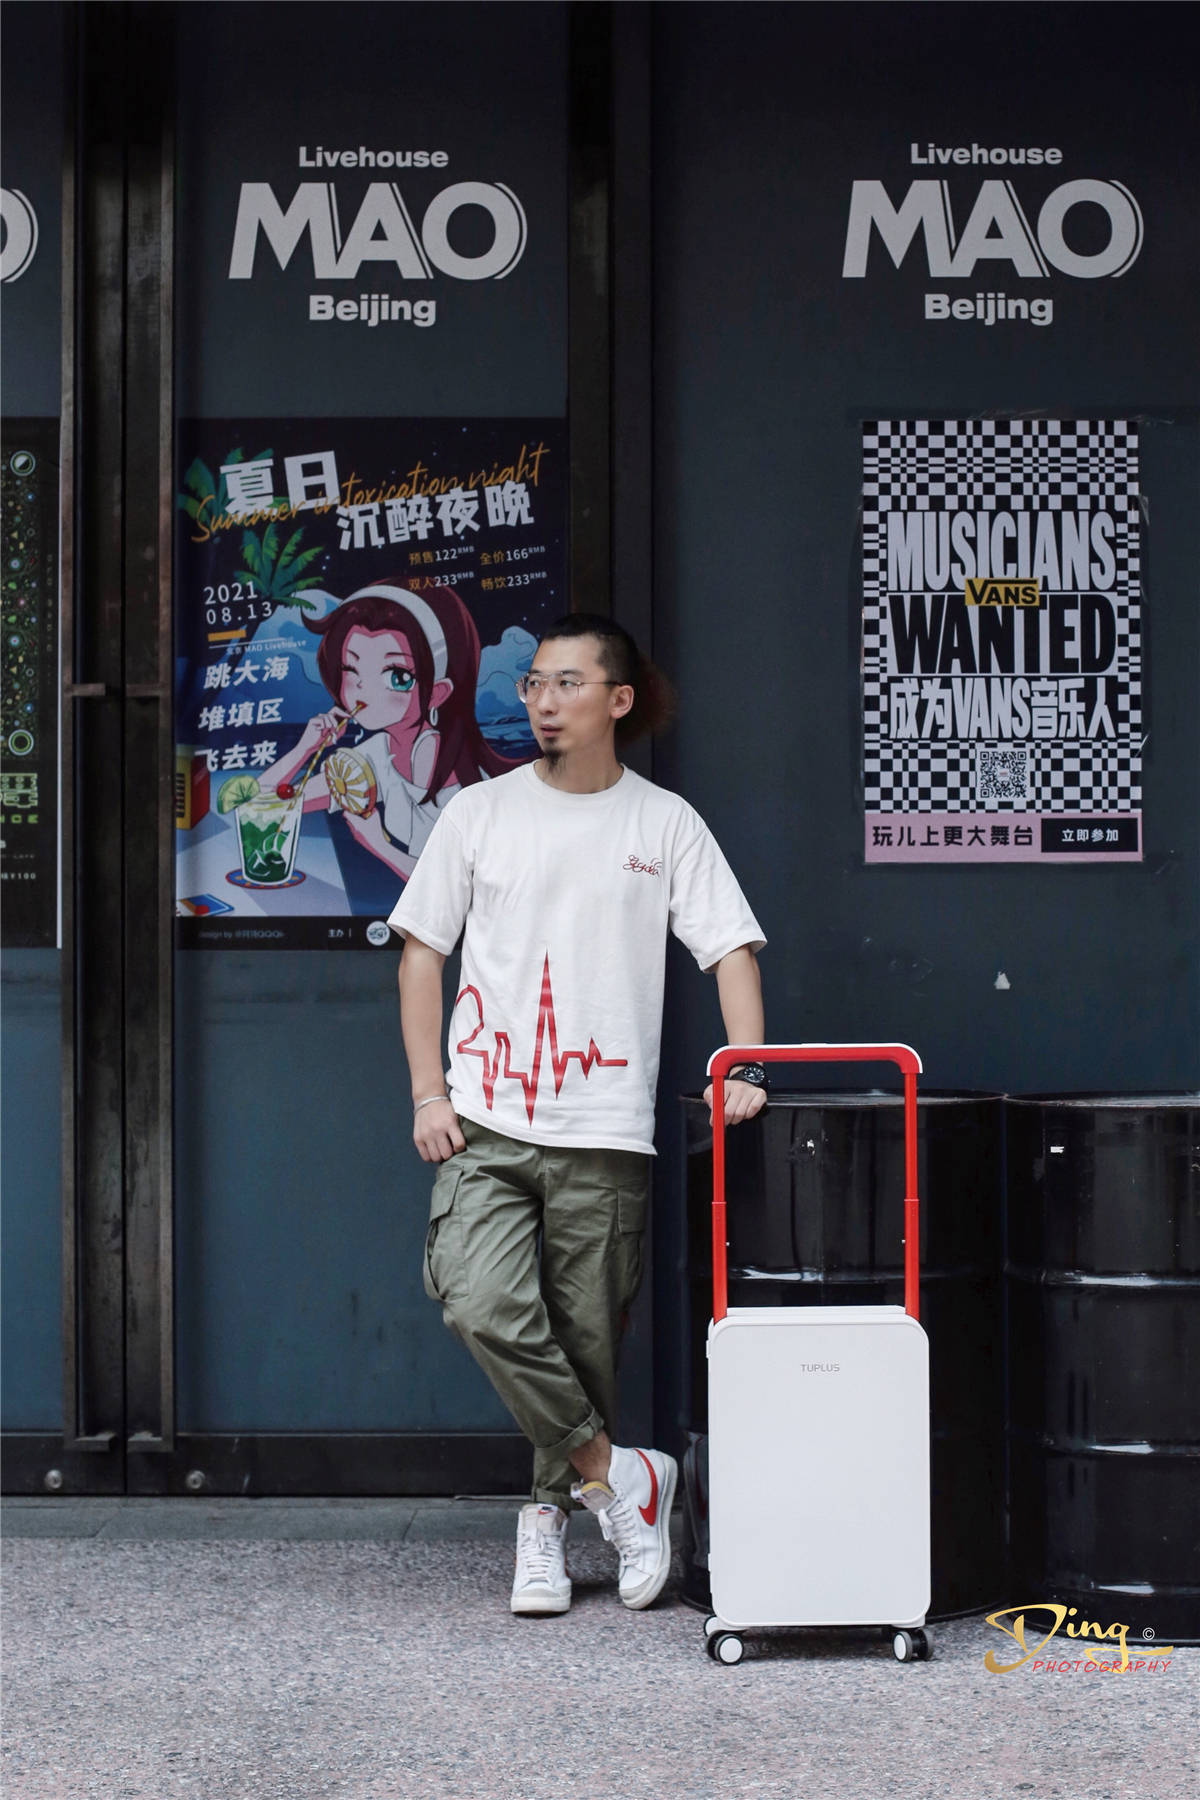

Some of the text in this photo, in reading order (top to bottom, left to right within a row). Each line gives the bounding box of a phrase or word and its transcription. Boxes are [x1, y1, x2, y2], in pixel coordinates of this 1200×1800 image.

[299, 146, 449, 168] Livehouse
[910, 143, 1063, 165] Livehouse
[228, 181, 528, 281] MAO
[842, 178, 1144, 279] MAO
[308, 294, 437, 327] Beijing
[924, 293, 1054, 326] Beijing
[191, 494, 307, 544] Summer
[468, 441, 550, 488] night
[219, 450, 340, 516] 夏日
[336, 480, 535, 551] 沉醉夜晚
[887, 510, 1117, 591] MUSICIANS
[203, 580, 258, 606] 2021
[967, 579, 1038, 605] VANS
[205, 600, 274, 625] 08.13
[889, 594, 1117, 674] WANTED
[203, 656, 290, 690] 跳大海
[197, 697, 284, 732] 堆填区
[889, 677, 1116, 739] 成为VANS音乐人
[194, 740, 278, 773] 飞去来
[872, 825, 1034, 847] 玩儿上更大舞台
[1061, 828, 1119, 842] 立即参加
[800, 1363, 841, 1373] TUPLUS
